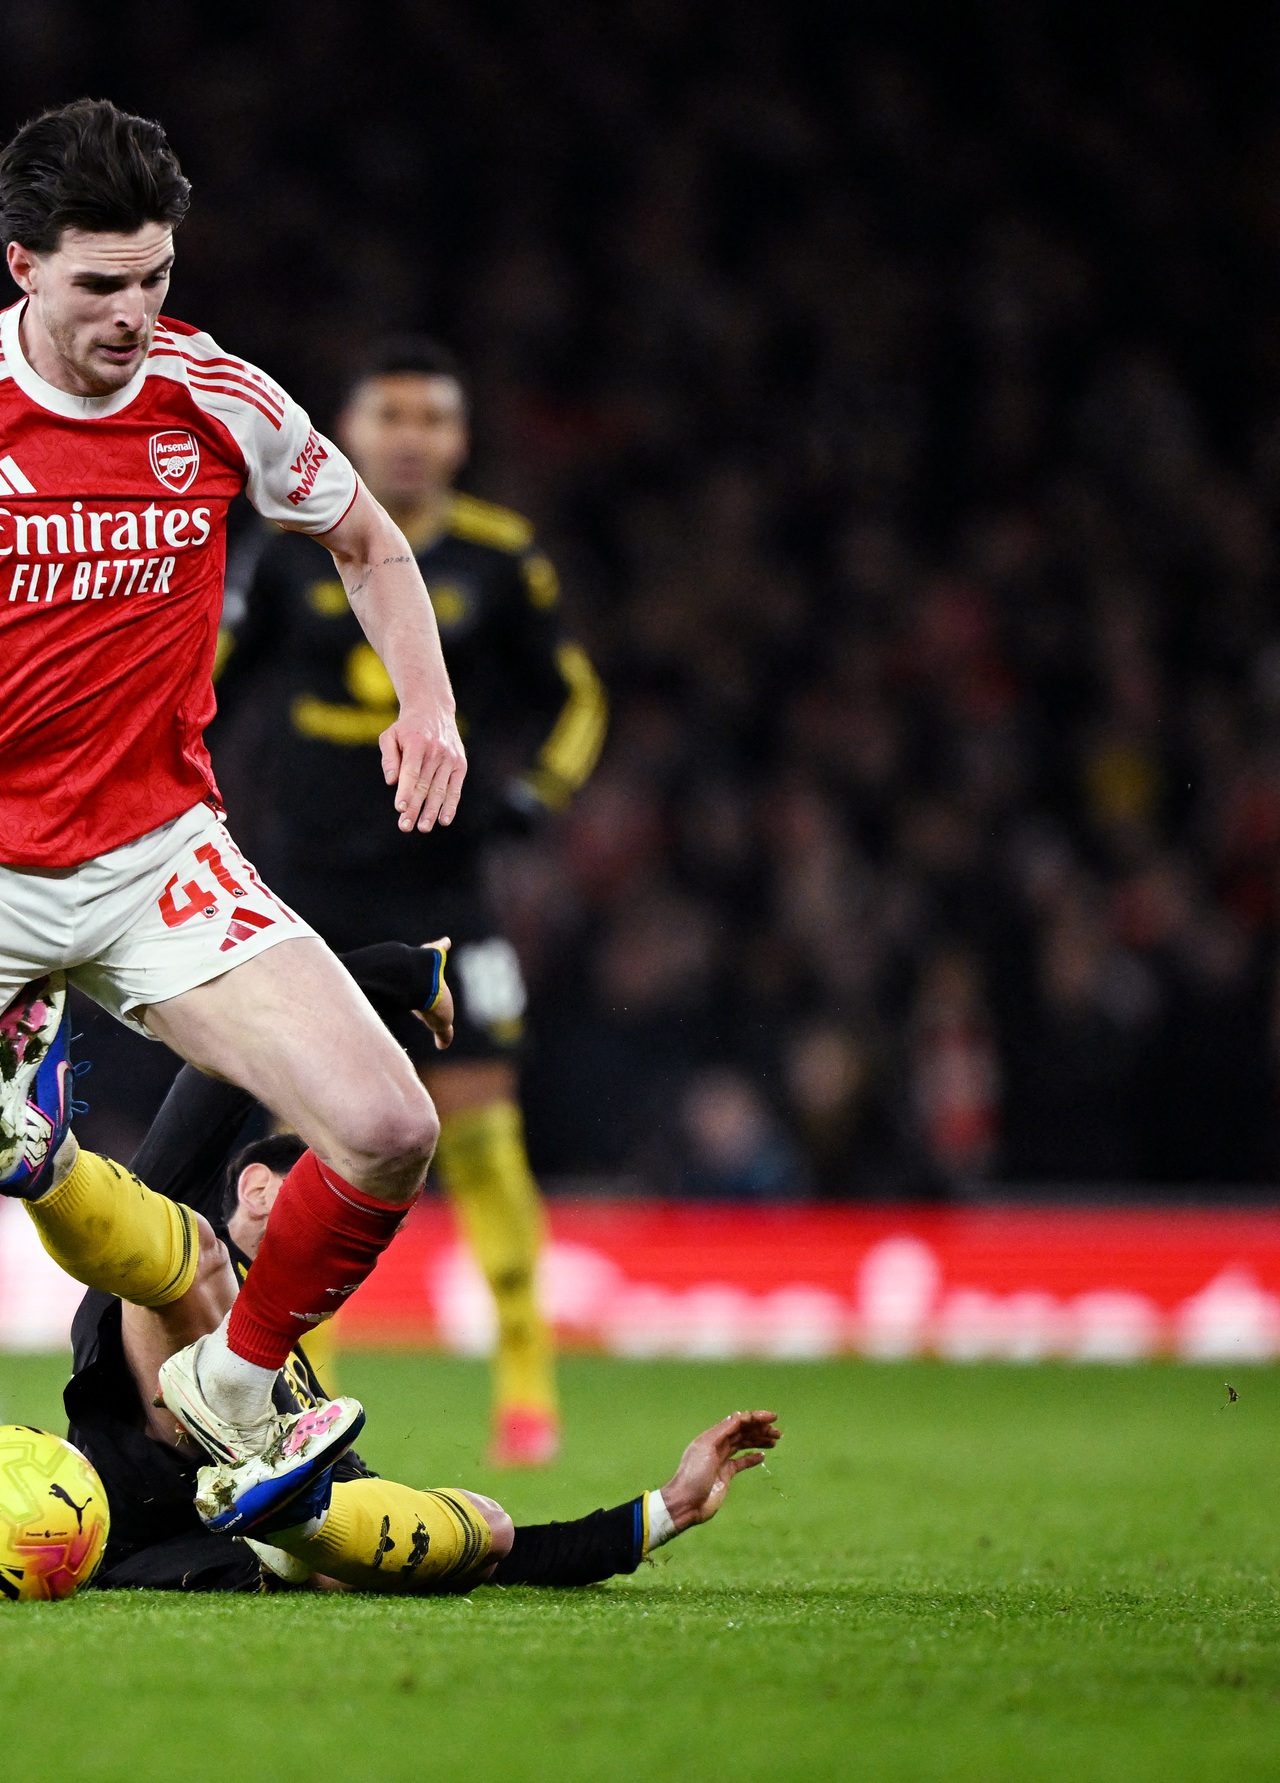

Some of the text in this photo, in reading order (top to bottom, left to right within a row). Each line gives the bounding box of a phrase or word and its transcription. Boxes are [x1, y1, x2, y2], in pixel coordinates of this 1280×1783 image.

[156, 440, 192, 454] Arsenal
[289, 426, 320, 475] VISIT
[8, 556, 176, 603] FLY BETTER
[157, 841, 249, 929] 41
